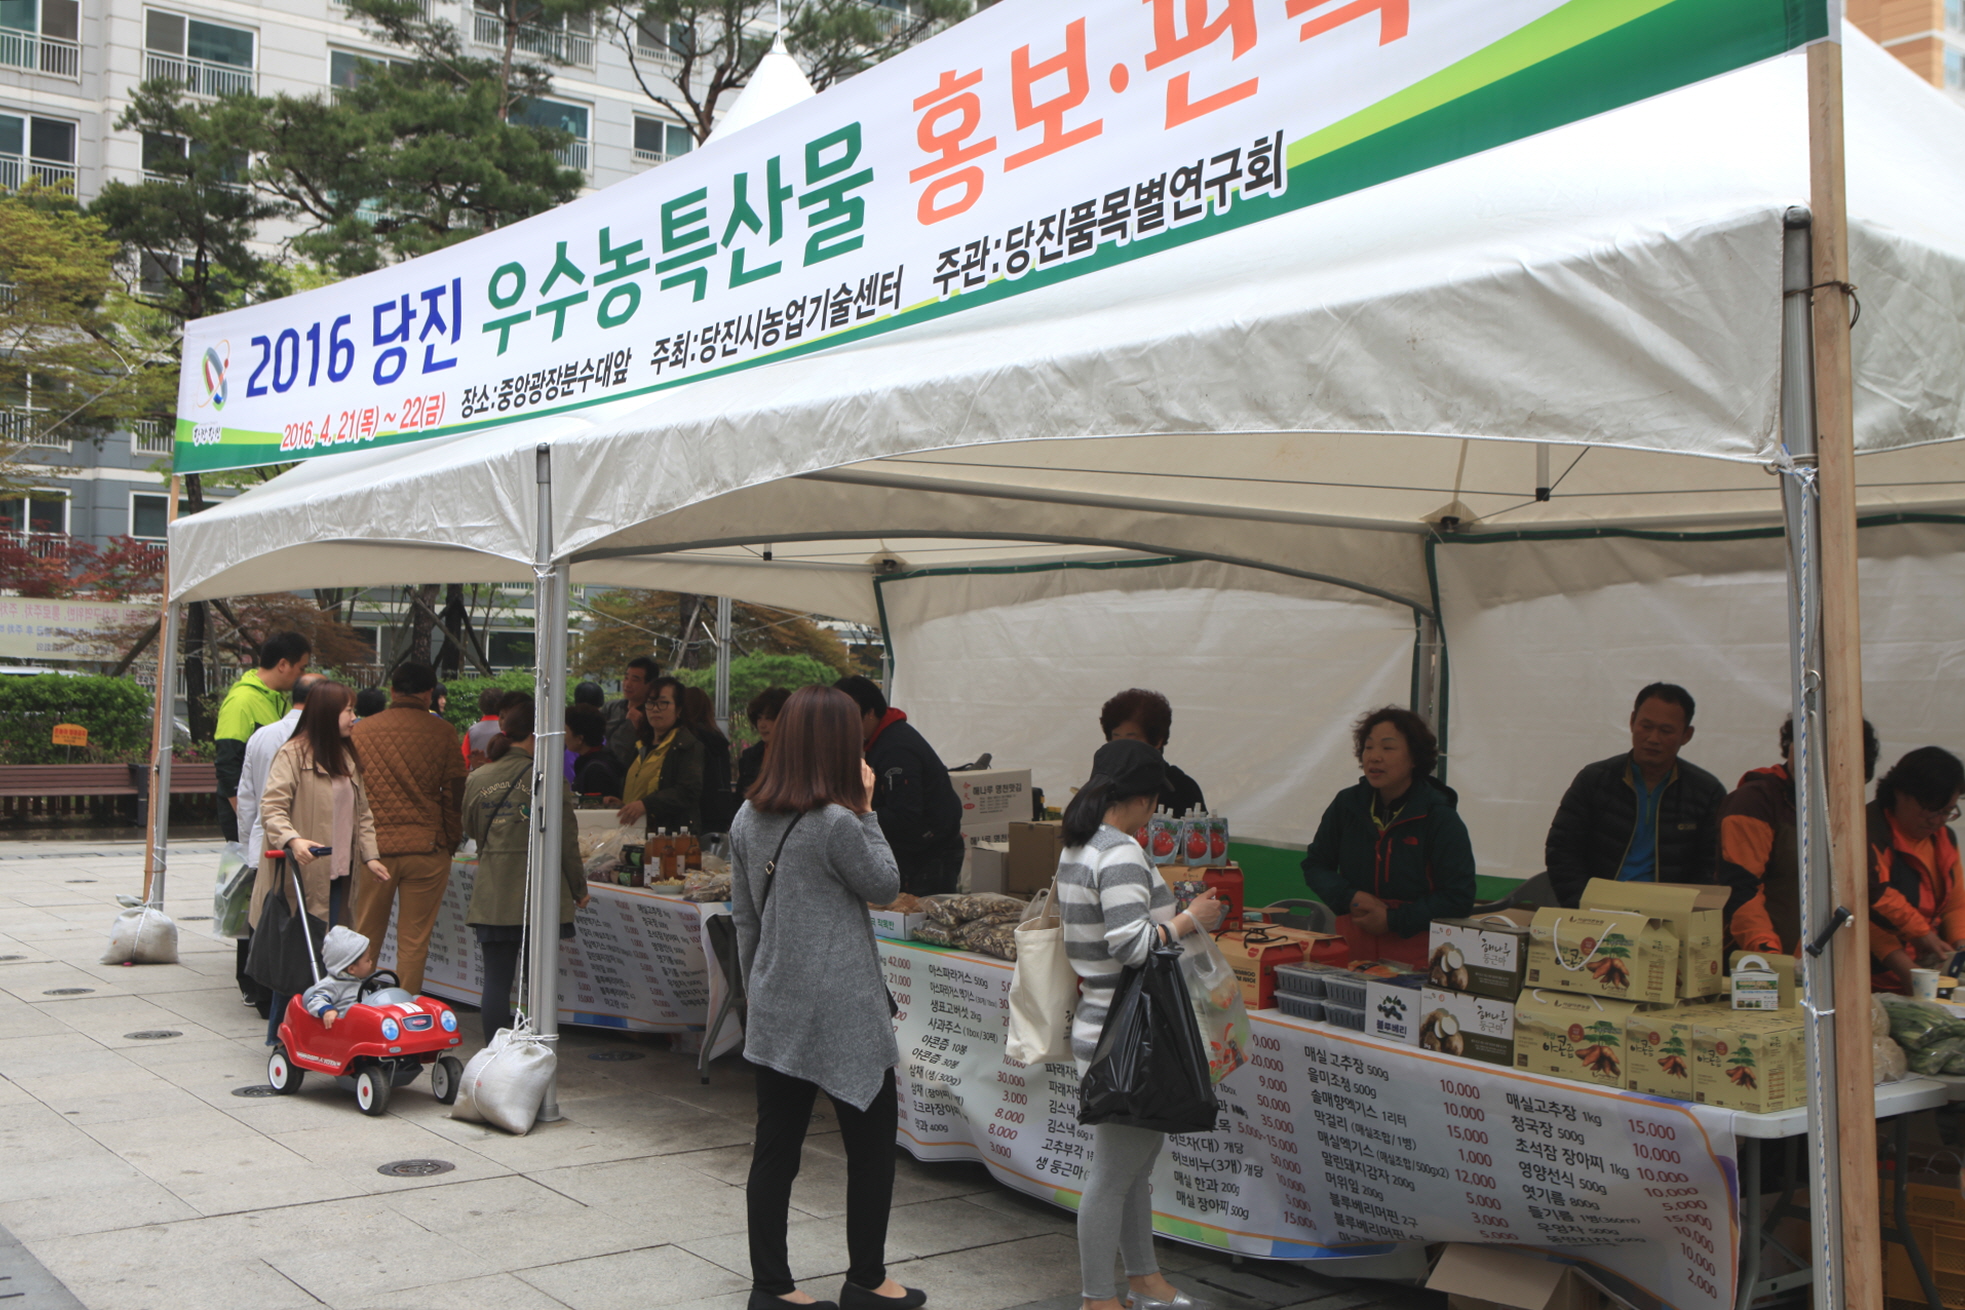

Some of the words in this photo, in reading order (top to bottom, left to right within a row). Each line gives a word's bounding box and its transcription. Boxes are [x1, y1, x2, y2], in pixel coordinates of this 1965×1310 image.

[931, 128, 1285, 296] 주관:당진품목별연구회
[245, 313, 355, 399] 2016
[372, 276, 462, 387] 당진
[481, 120, 874, 358] 우수농특산물
[650, 264, 904, 375] 주최:당진시농업기술센터
[461, 347, 633, 419] 장소:중앙광장분수대앞
[281, 420, 315, 449] 2016.
[319, 413, 332, 443] 4.
[336, 405, 380, 440] 21(목)
[399, 391, 447, 430] 22(금)
[888, 956, 911, 970] 42,000
[1482, 953, 1507, 967] 둥근마
[889, 972, 912, 988] 21,000
[928, 964, 973, 984] 아스파라거스
[974, 976, 989, 990] 500g
[930, 999, 969, 1020] 생표고버섯
[969, 1010, 982, 1023] 2kg
[927, 1017, 962, 1035] 사과주스
[1376, 1018, 1407, 1035] 블루베리
[1478, 1020, 1504, 1035] 둥근마
[921, 1034, 950, 1052] 야콘즙
[951, 1043, 968, 1056] 10봉
[1542, 1034, 1575, 1059] 야콘즙
[1629, 1039, 1654, 1058] 야콘즙
[911, 1047, 942, 1065] 야콘즙
[940, 1058, 960, 1070] 30봉
[1250, 1053, 1284, 1073] 20,000
[1696, 1049, 1722, 1068] 야콘즙
[908, 1063, 924, 1079] 삼채
[997, 1070, 1026, 1088] 30,000
[1258, 1075, 1288, 1094] 9,000
[1304, 1046, 1328, 1066] 매실
[1329, 1052, 1364, 1075] 고추장
[1367, 1065, 1390, 1082] 500g
[1440, 1078, 1481, 1100] 10,000
[910, 1082, 924, 1097] 삼채
[1002, 1090, 1028, 1106] 3,000
[1256, 1094, 1291, 1114] 50,000
[1353, 1083, 1377, 1100] 500g
[1443, 1101, 1485, 1122] 10,000
[994, 1107, 1025, 1125] 8,000
[1048, 1099, 1076, 1118] 김스낵
[1311, 1088, 1378, 1119] 솔매향엑기스
[1382, 1111, 1407, 1128] 1리터
[1446, 1124, 1489, 1145] 15,000
[1505, 1092, 1577, 1122] 매실고추장
[1581, 1111, 1603, 1128] 1kg
[1628, 1118, 1676, 1142] 15,000
[987, 1123, 1019, 1141] 8,000
[1047, 1119, 1075, 1138] 김스낵
[1260, 1114, 1295, 1134] 35,000
[989, 1141, 1012, 1159] 3,000
[1041, 1138, 1084, 1160] 고추부각
[1314, 1109, 1348, 1133] 막걸리
[1458, 1148, 1493, 1168] 1,000
[1510, 1114, 1554, 1139] 청국장
[1557, 1127, 1586, 1146] 500g
[1632, 1142, 1681, 1165] 10,000
[1168, 1133, 1220, 1154] 허브차(대)
[1223, 1141, 1244, 1155] 개당
[1270, 1153, 1302, 1175] 50,000
[1317, 1130, 1375, 1159] 매실엑기스
[1454, 1168, 1497, 1190] 12,000
[1515, 1137, 1558, 1162] 초석잠
[1561, 1147, 1605, 1174] 장아찌
[1609, 1163, 1631, 1180] 1kg
[1636, 1166, 1690, 1184] 10,000
[1035, 1156, 1049, 1171] 생
[1050, 1159, 1084, 1180] 둥근마
[1171, 1151, 1242, 1175] 허브비누(3개)
[1243, 1163, 1264, 1178] 개당
[1276, 1172, 1306, 1194] 10,000
[1321, 1150, 1390, 1184] 말린돼지감자
[1391, 1174, 1416, 1192] 200g
[1465, 1191, 1502, 1211] 5,000
[1518, 1160, 1575, 1189] 영양선식
[1579, 1178, 1608, 1196] 500g
[1643, 1187, 1699, 1198] 10,000
[1173, 1170, 1193, 1189] 매실
[1194, 1176, 1219, 1193] 한과
[1220, 1181, 1241, 1197] 200g
[1285, 1193, 1312, 1213] 5,000
[1522, 1184, 1566, 1207] 엿기름
[1569, 1197, 1601, 1211] 800g
[1661, 1199, 1708, 1212] 5,000
[1176, 1190, 1196, 1209] 매실
[1197, 1198, 1230, 1216] 장아찌
[1230, 1207, 1250, 1221] 500g
[1283, 1211, 1318, 1231] 15,000
[1329, 1191, 1400, 1225] 블루베리머핀
[1401, 1215, 1419, 1229] 2구
[1479, 1229, 1520, 1241] 5,000
[1361, 1185, 1385, 1202] 200g
[1471, 1211, 1510, 1229] 3,000
[1527, 1205, 1575, 1223] 들기름
[1662, 1213, 1713, 1232] 15,000
[1673, 1225, 1715, 1255] 10,000
[1680, 1242, 1716, 1278] 10,000
[1686, 1267, 1718, 1300] 2,000
